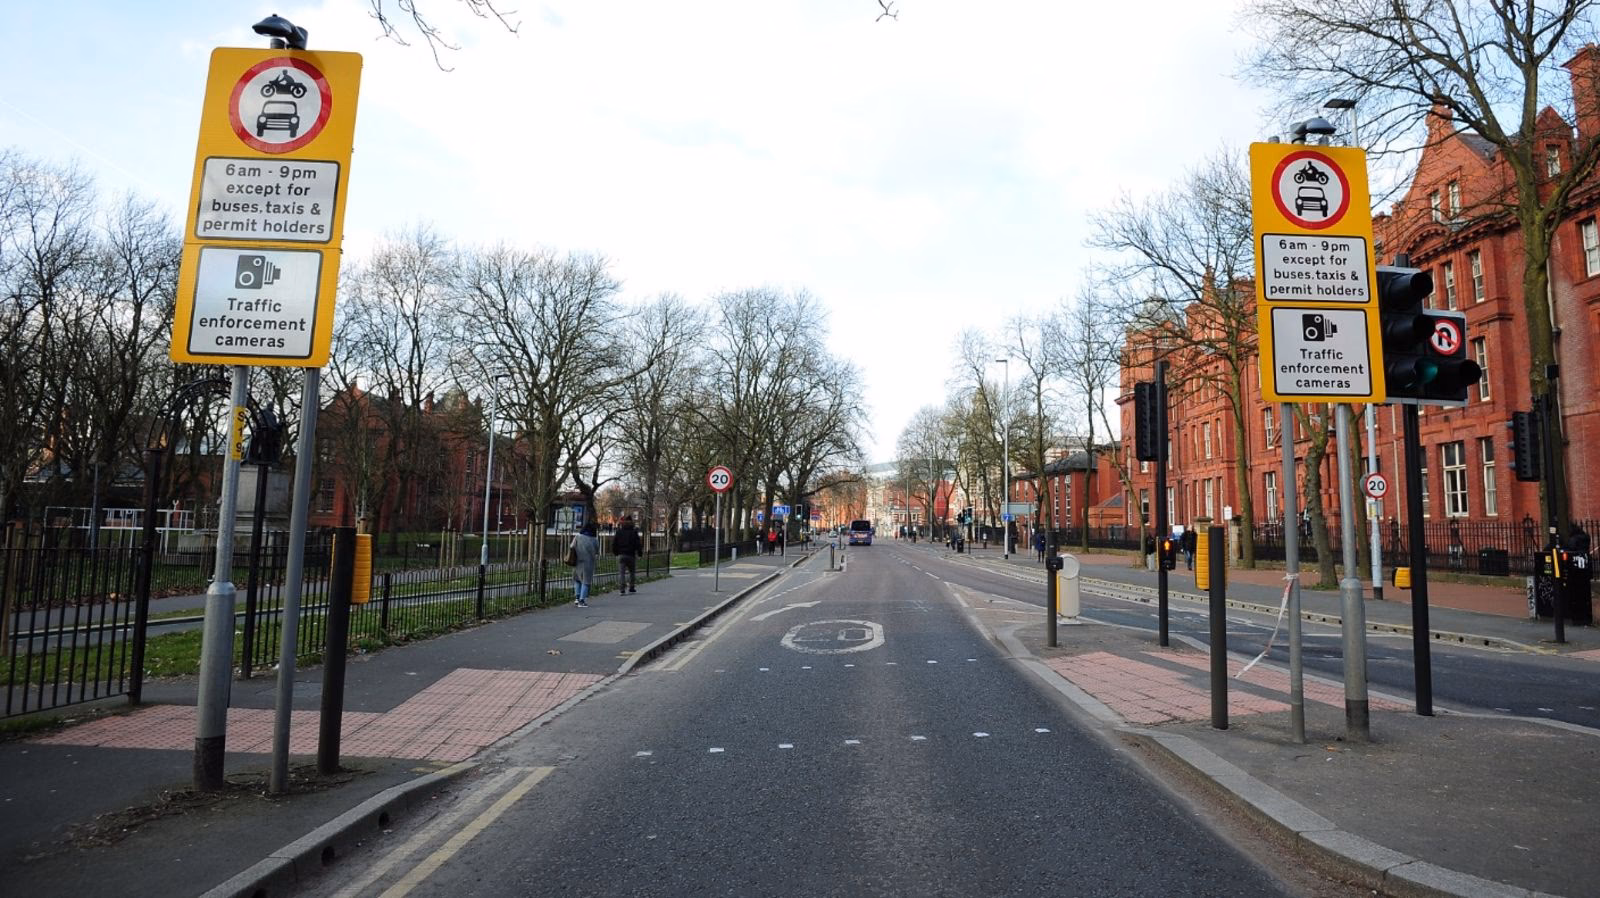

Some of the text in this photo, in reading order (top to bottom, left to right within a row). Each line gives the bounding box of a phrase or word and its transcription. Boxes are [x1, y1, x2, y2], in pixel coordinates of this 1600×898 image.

[225, 163, 261, 177] 6am
[280, 166, 317, 180] 9pm
[226, 183, 310, 197] except for
[266, 201, 304, 215] taxis
[310, 203, 321, 215] &
[203, 219, 325, 234] permit holders
[1279, 239, 1307, 250] 6am
[1321, 240, 1349, 252] 9pm
[1282, 255, 1347, 266] except for
[1316, 270, 1346, 280] taxis
[1350, 271, 1359, 281] &
[1270, 284, 1364, 296] permit holders
[227, 298, 282, 312] Traffic
[199, 315, 306, 331] enforcement
[215, 335, 285, 348] cameras
[1299, 348, 1343, 360] Traffic
[1280, 362, 1364, 374] enforcement
[1295, 379, 1351, 388] cameras
[712, 474, 729, 484] 20
[1369, 480, 1385, 491] 20
